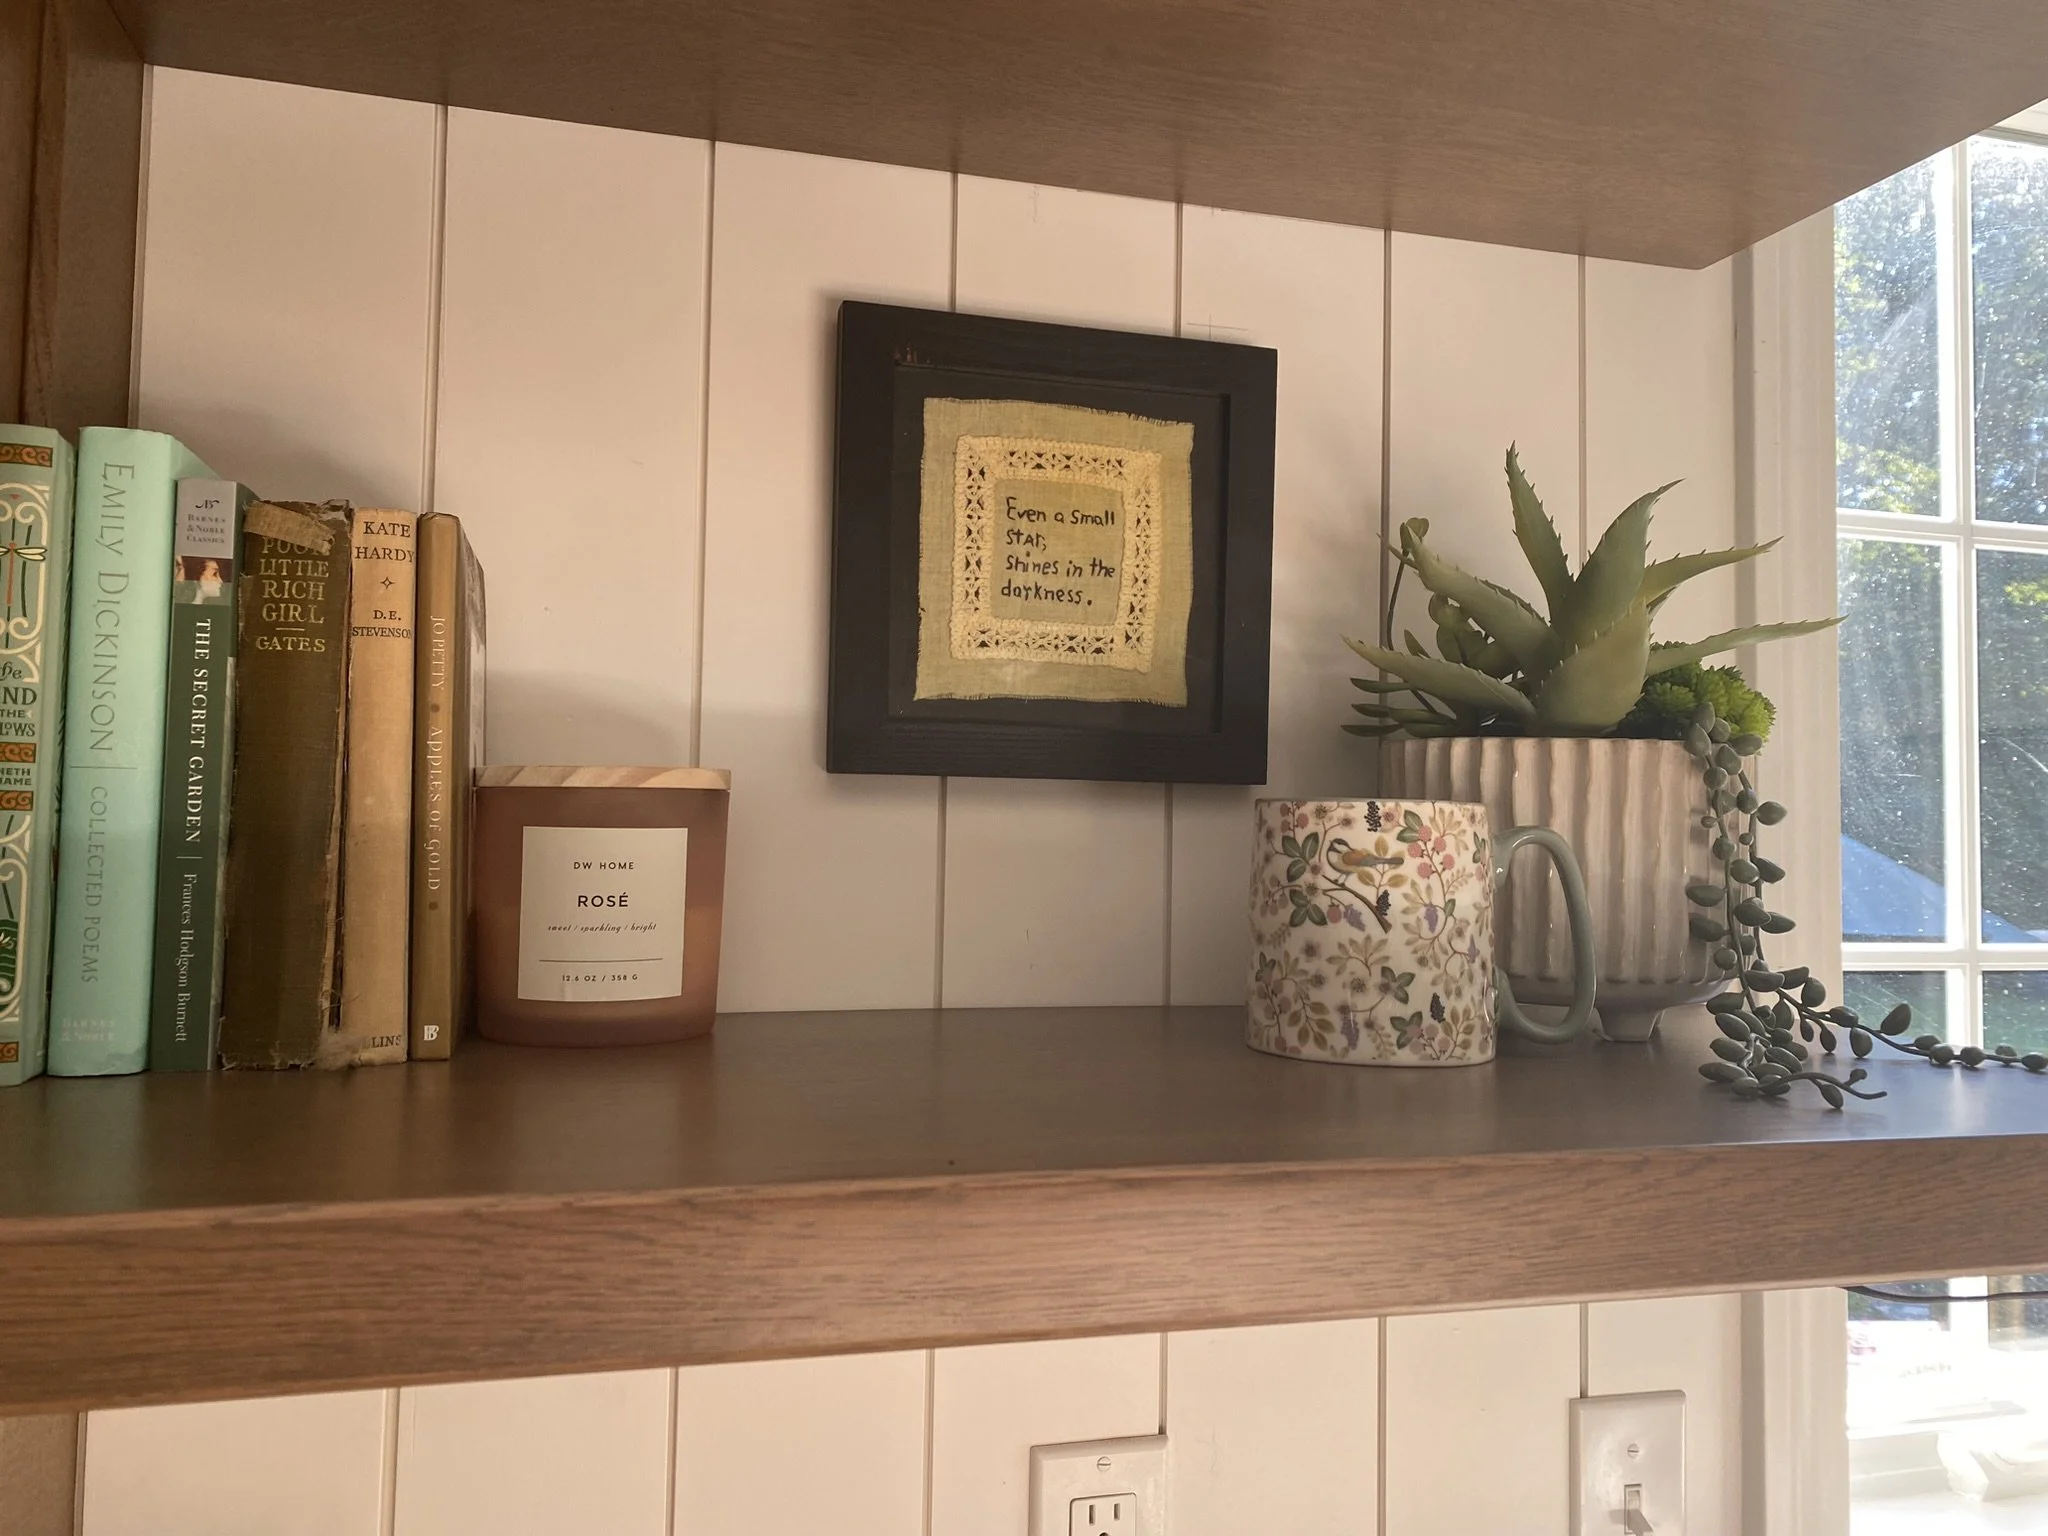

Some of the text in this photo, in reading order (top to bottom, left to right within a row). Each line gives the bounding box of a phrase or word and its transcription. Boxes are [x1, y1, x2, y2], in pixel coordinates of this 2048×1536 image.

[188, 513, 226, 524] BARNES
[1005, 496, 1047, 522] Even
[1054, 511, 1064, 524] a
[363, 521, 411, 538] KATE
[261, 537, 320, 556] POO
[355, 546, 415, 563] HARDY
[259, 558, 330, 578] LITTLE
[1066, 560, 1084, 578] in
[1089, 557, 1116, 578] the
[262, 579, 326, 601] RICH
[1001, 578, 1093, 606] darkness.
[89, 462, 134, 751] EMILY DICKINSON
[262, 603, 325, 624] GIRL
[256, 636, 326, 652] GATES
[0, 661, 22, 681] he
[2, 686, 38, 706] ND
[0, 722, 36, 738] LOWS
[185, 618, 212, 844] THE SECRET GARDEN
[573, 861, 635, 870] DW HOME
[81, 786, 108, 984] COLLECTED POEMS
[577, 891, 629, 908] ROSÉ
[580, 922, 622, 934] sparkling
[630, 921, 657, 933] bright
[175, 873, 197, 1042] Frances Hodgson Burnett
[561, 974, 580, 982] 12.6
[583, 974, 597, 982] OZ
[631, 973, 638, 981] G
[371, 1034, 403, 1049] LINS
